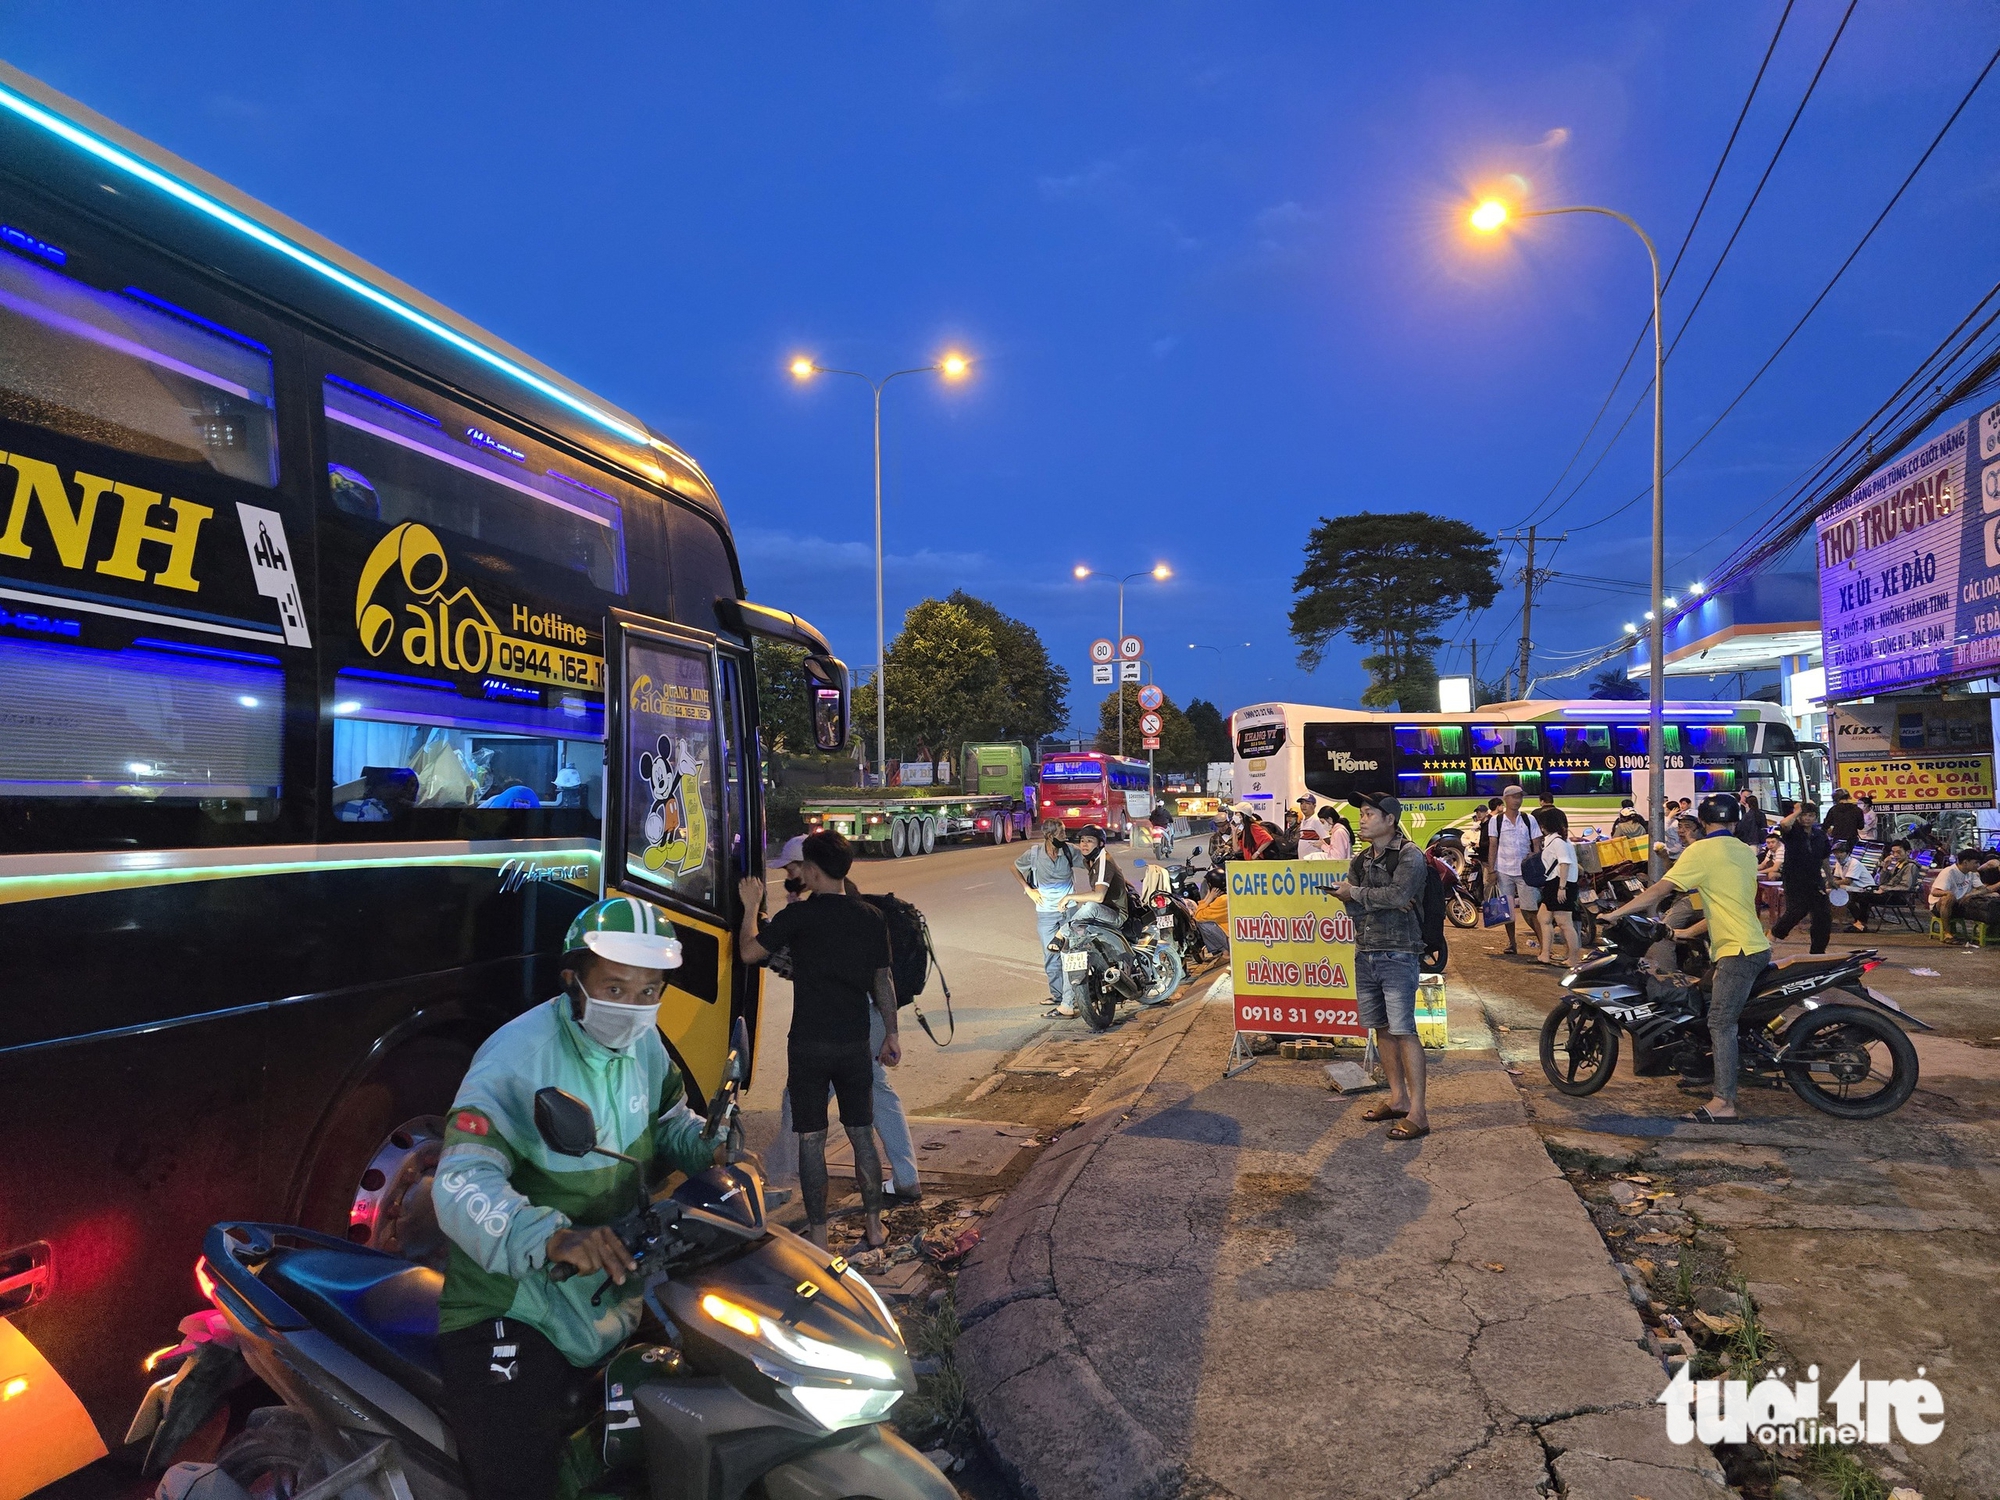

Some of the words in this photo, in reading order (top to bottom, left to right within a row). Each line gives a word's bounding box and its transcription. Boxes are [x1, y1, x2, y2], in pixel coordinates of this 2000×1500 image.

[0, 451, 214, 592] NH
[1821, 518, 1857, 571] THỌ
[1839, 584, 1855, 614] XE
[1881, 566, 1899, 600] XE
[1902, 549, 1936, 592] ĐÀO
[1963, 578, 1981, 603] CÁC
[1981, 575, 2000, 600] LOẠ
[512, 603, 588, 647] Hotline
[1974, 614, 1986, 635] XE
[1096, 645, 1108, 656] 80
[1125, 642, 1136, 653] 60
[690, 687, 709, 703] MINH
[1838, 724, 1883, 736] Kixx
[1327, 750, 1351, 761] New
[1471, 756, 1523, 771] KHANG
[1526, 756, 1544, 771] VY
[1618, 755, 1684, 769] 19002766
[1333, 758, 1379, 773] Home
[1881, 763, 1912, 773] THỌ
[1917, 760, 1982, 770] TRƯƠNG
[1850, 773, 1888, 787] BÁN
[1896, 772, 1930, 785] CÁC
[1937, 772, 1980, 785] LOẠI
[1885, 788, 1907, 798] XE
[1915, 787, 1939, 797] CƠ
[1946, 783, 1988, 796] GIỚI
[1232, 873, 1268, 896] CAFE
[1272, 866, 1295, 896] CÔ
[1236, 911, 1288, 946] NHẬN
[1291, 911, 1316, 941] KÝ
[1320, 910, 1354, 942] GỬI
[1246, 955, 1300, 985] HÀNG
[1303, 957, 1348, 987] HÓA
[1241, 1006, 1283, 1022] 0918
[1288, 1007, 1307, 1023] 31
[1314, 1009, 1359, 1026] 9922
[442, 1169, 510, 1238] Grab
